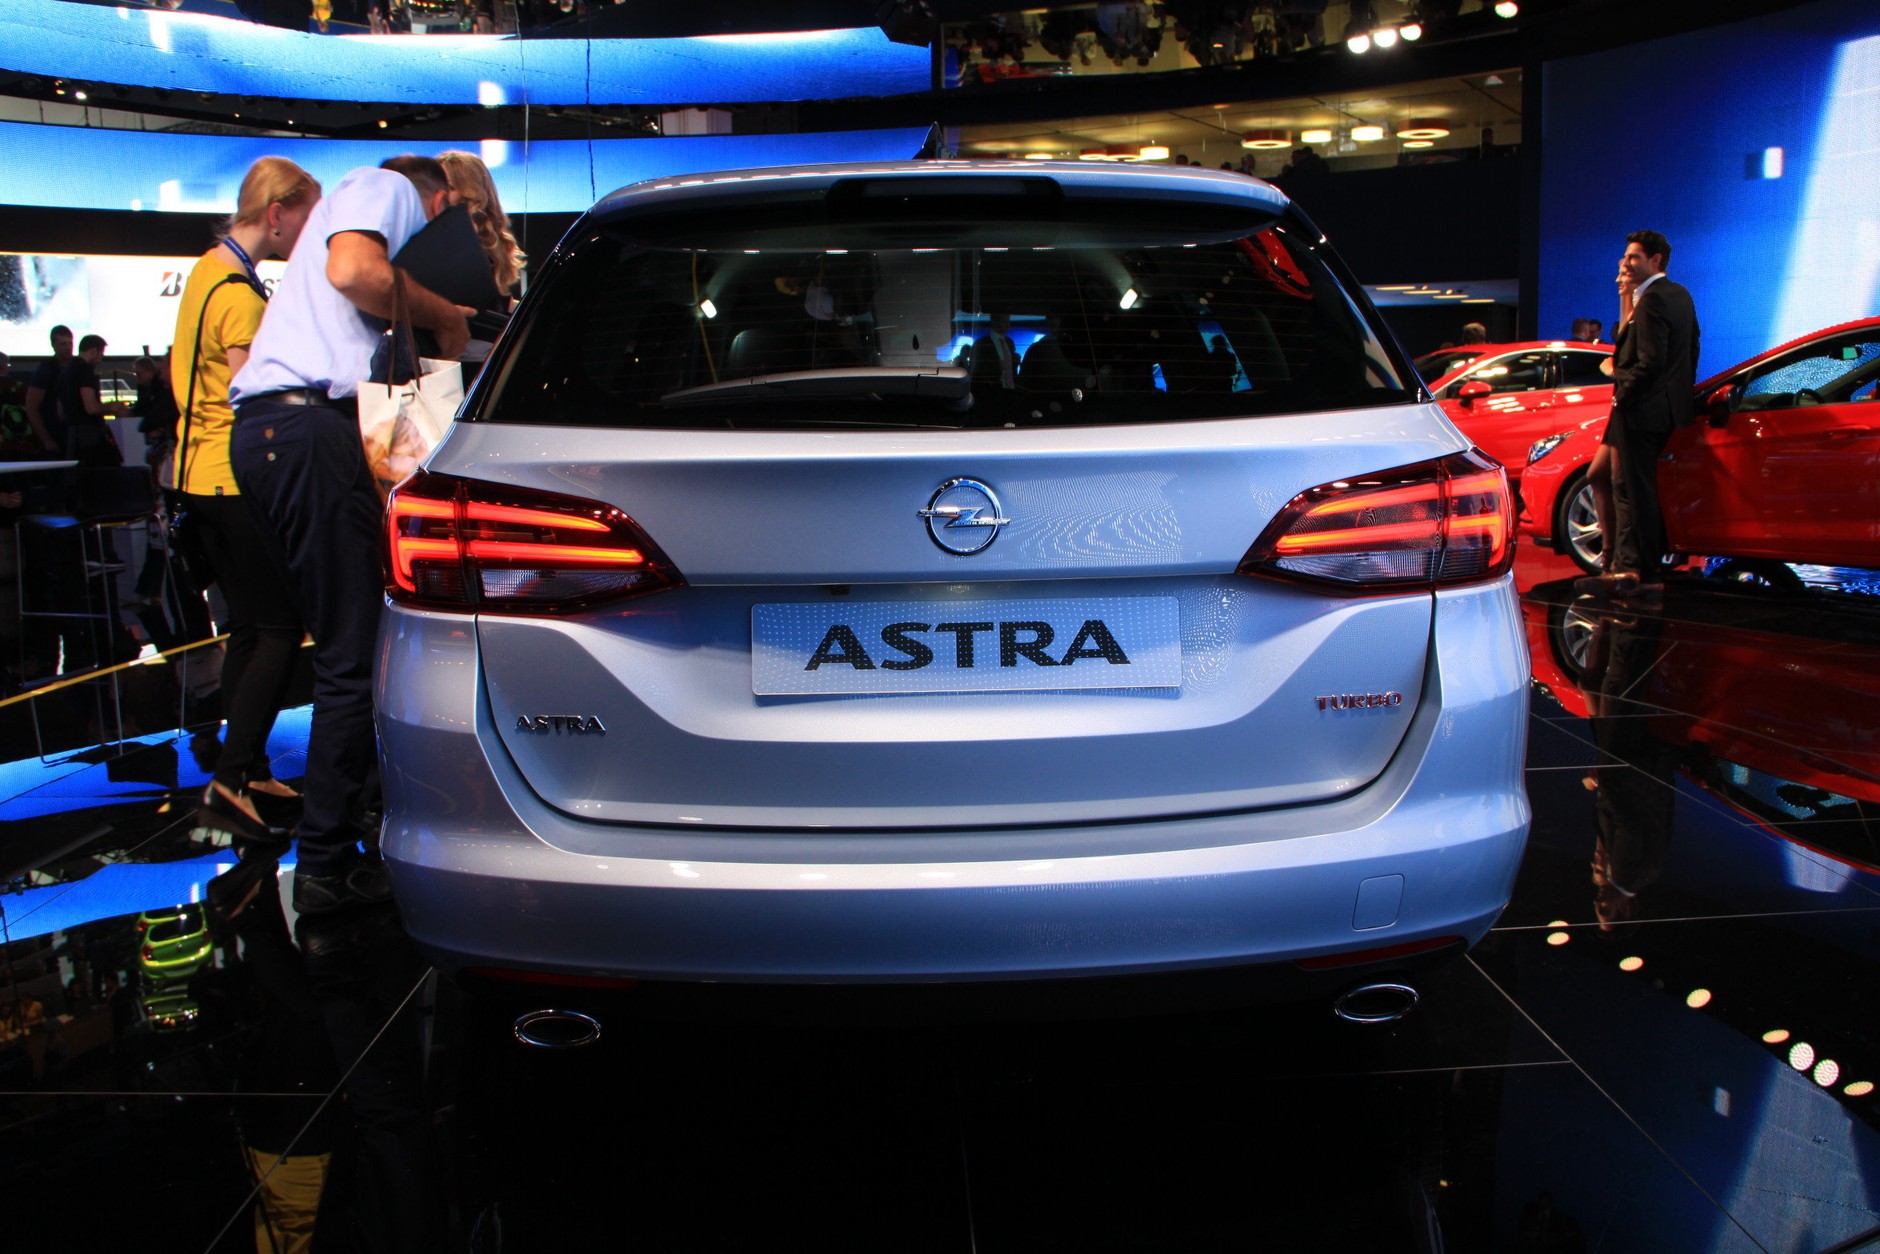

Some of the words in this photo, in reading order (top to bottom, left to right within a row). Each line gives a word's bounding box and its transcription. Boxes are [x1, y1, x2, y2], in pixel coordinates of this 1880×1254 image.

[804, 620, 1131, 671] ASTRA
[1314, 691, 1402, 710] TURBO
[515, 714, 606, 733] ASTRA
